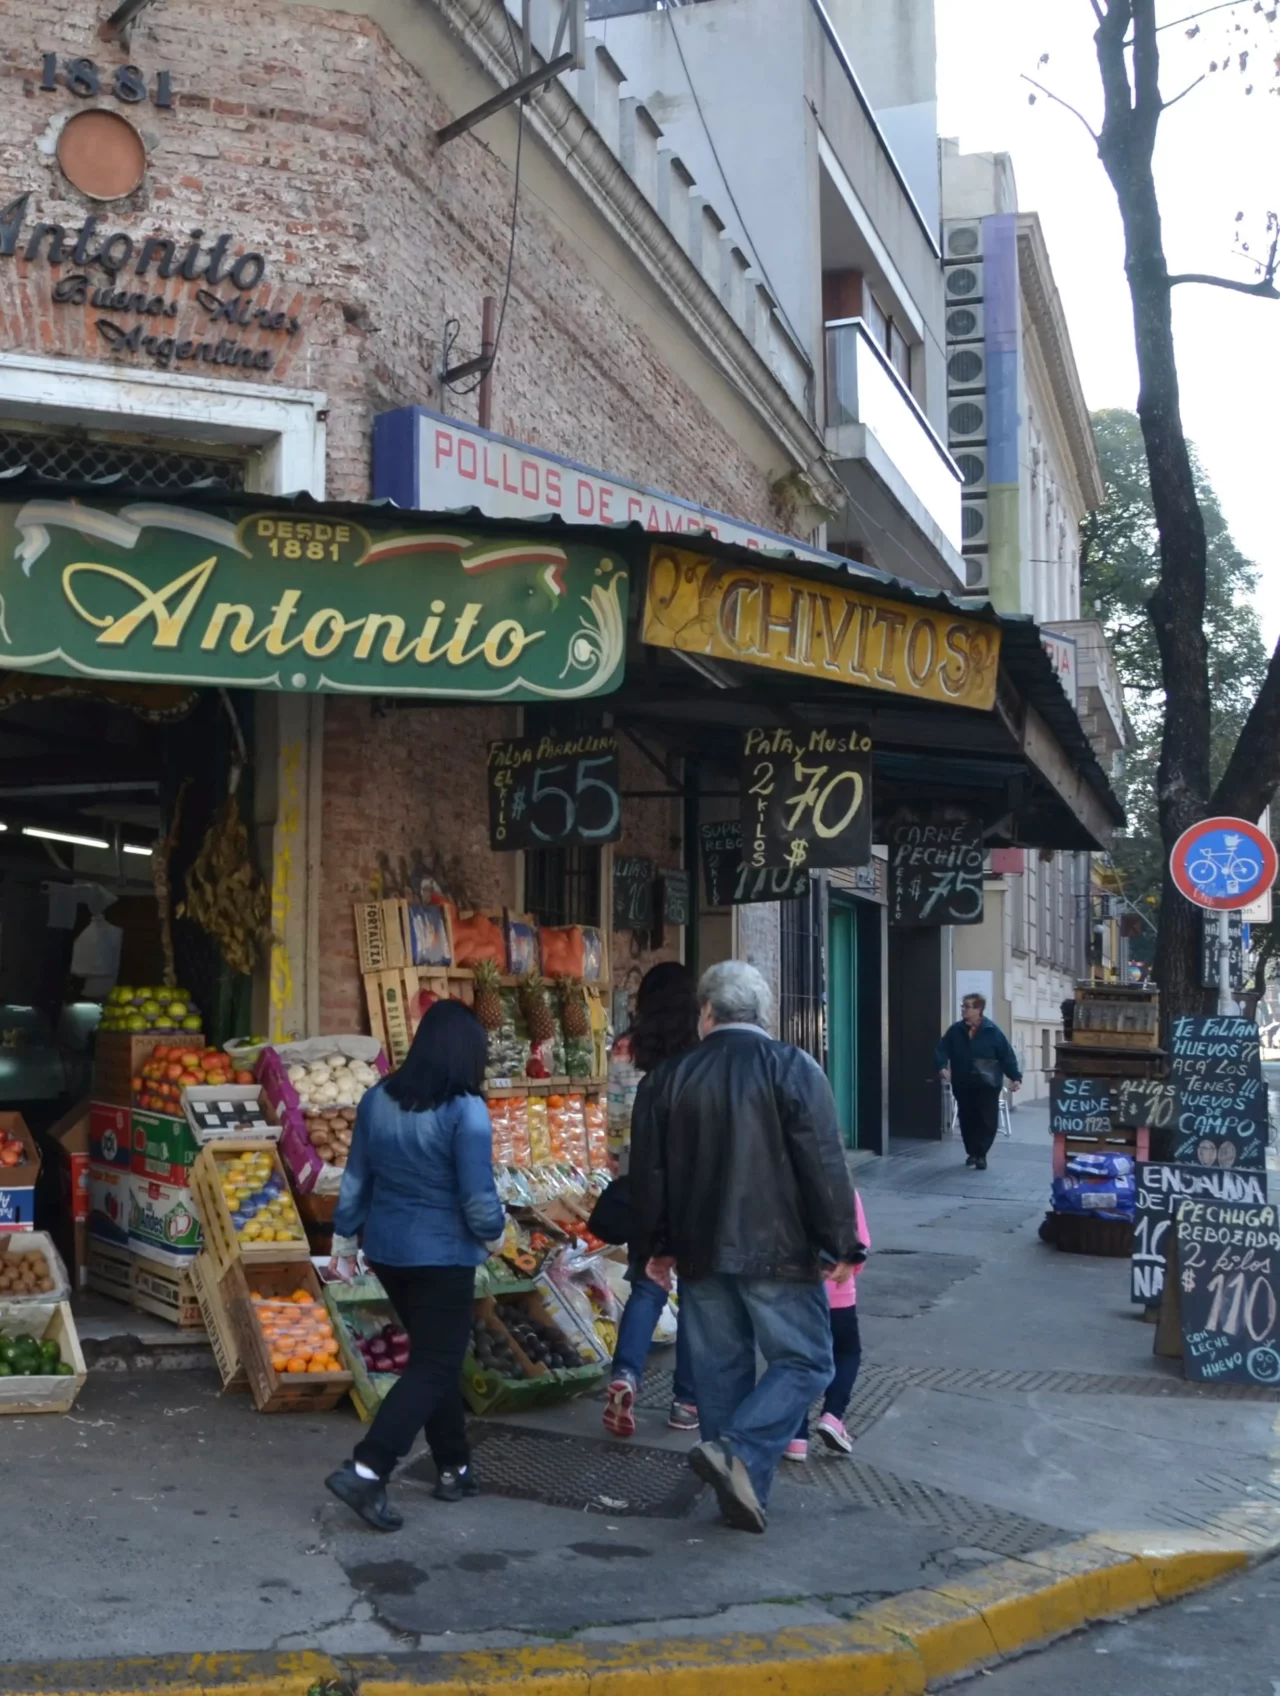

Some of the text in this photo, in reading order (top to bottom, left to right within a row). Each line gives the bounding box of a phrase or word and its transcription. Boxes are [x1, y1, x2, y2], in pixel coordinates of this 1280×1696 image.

[39, 52, 174, 110] 1881
[52, 274, 301, 335] Buenos Aires
[94, 318, 274, 372] Argentina
[433, 429, 563, 509] POLLOS
[577, 478, 614, 526] DE
[257, 517, 351, 544] DESDE
[268, 539, 341, 563] 1881
[61, 555, 547, 668] Antonito
[717, 573, 972, 699] CHIVITOS
[748, 761, 775, 795] 2
[530, 755, 620, 841] 55
[785, 761, 864, 838] 70
[751, 798, 769, 867] KILOS
[783, 838, 809, 868] $
[919, 871, 983, 919] 75
[366, 904, 381, 967] FORTALEZA
[1173, 1016, 1258, 1038] TE FALTAN
[1172, 1058, 1249, 1076] ACÁ LOS
[1063, 1079, 1093, 1096] SE
[1120, 1079, 1177, 1097] ALITAS
[1057, 1097, 1110, 1116] VENDE
[1144, 1095, 1174, 1128] 10
[1205, 1107, 1223, 1117] DE
[1054, 1114, 1084, 1132] AÑO
[1178, 1112, 1256, 1137] CAMPO
[1135, 1187, 1165, 1210] DE
[1176, 1200, 1274, 1227] PECHUGA
[1177, 1222, 1280, 1251] REBOZADA
[1184, 1242, 1206, 1268] 2
[1181, 1268, 1277, 1342] $ 110
[1186, 1330, 1208, 1344] CON
[1190, 1334, 1230, 1357] LECHE
[1201, 1351, 1244, 1378] HUEVO
